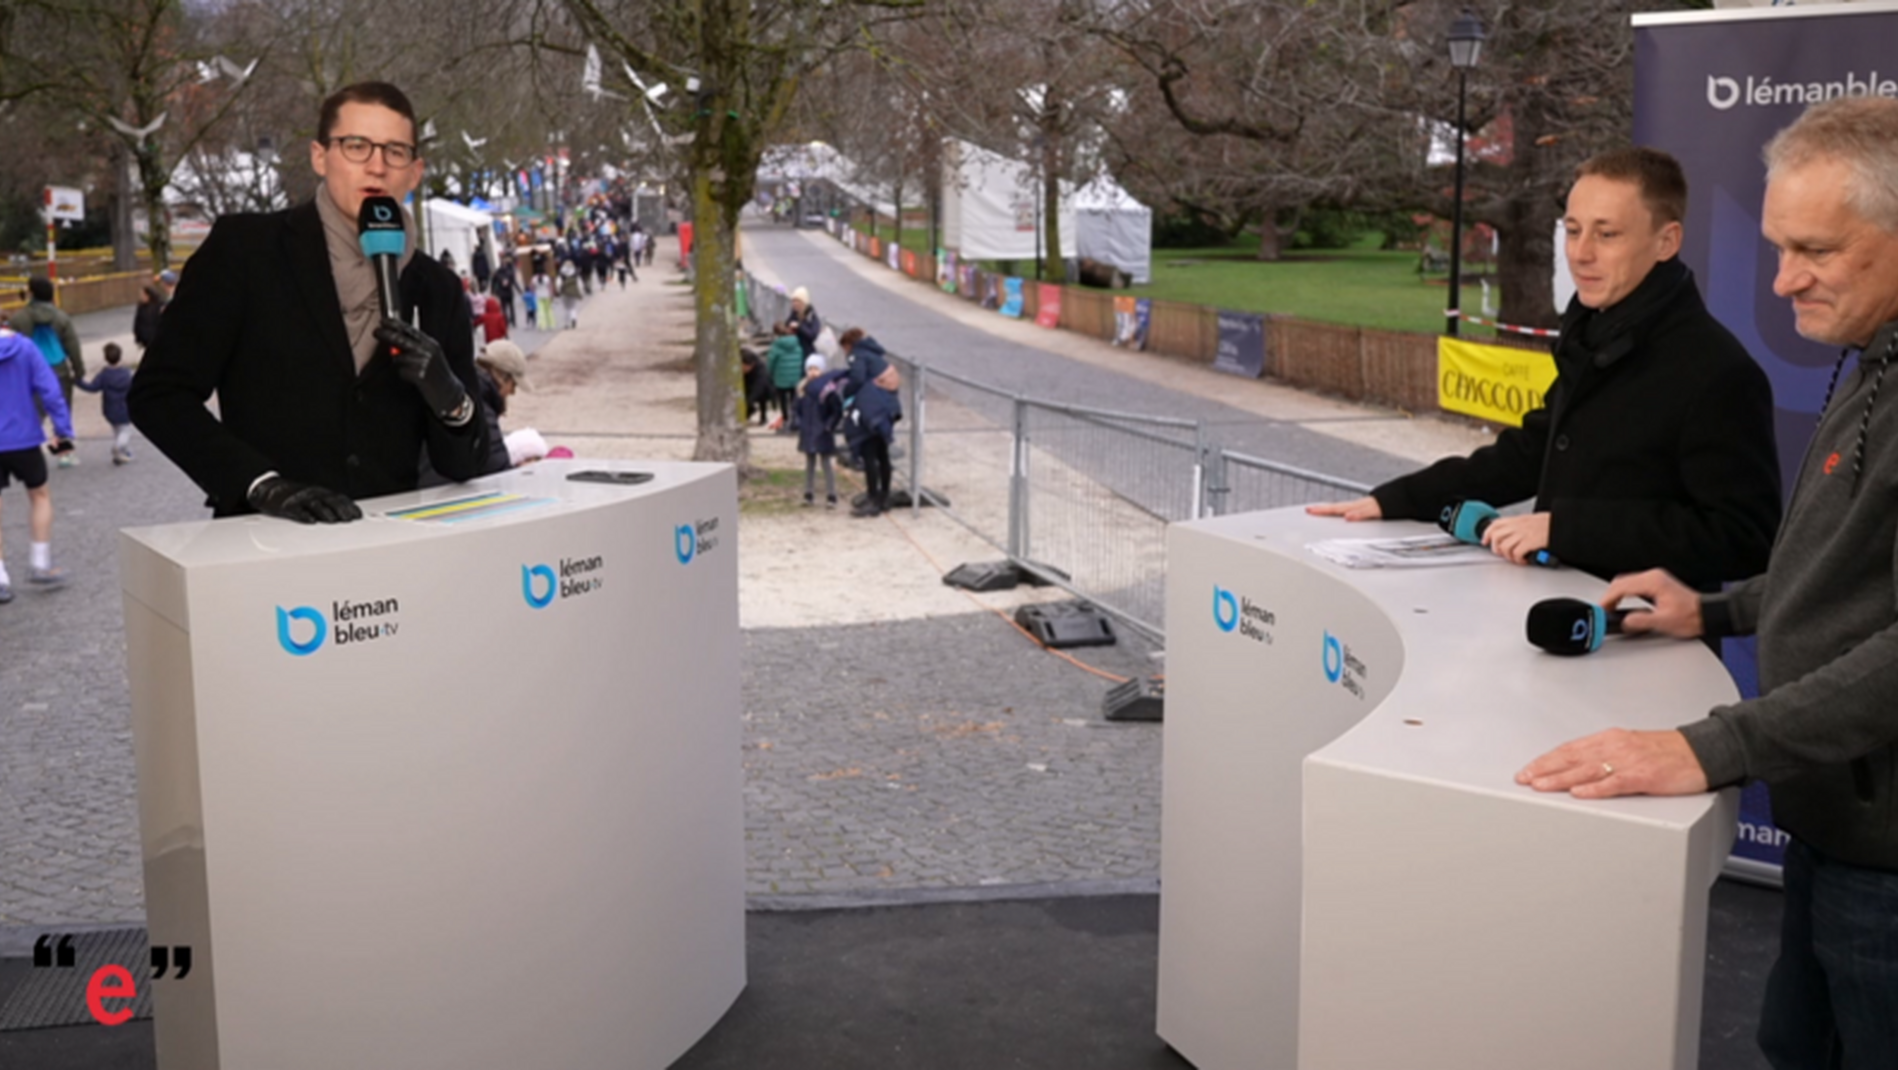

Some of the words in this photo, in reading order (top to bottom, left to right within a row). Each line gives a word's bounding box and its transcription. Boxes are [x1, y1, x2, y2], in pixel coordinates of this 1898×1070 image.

[560, 556, 603, 577] léman
[333, 598, 398, 621] léman
[1241, 596, 1275, 626] léman
